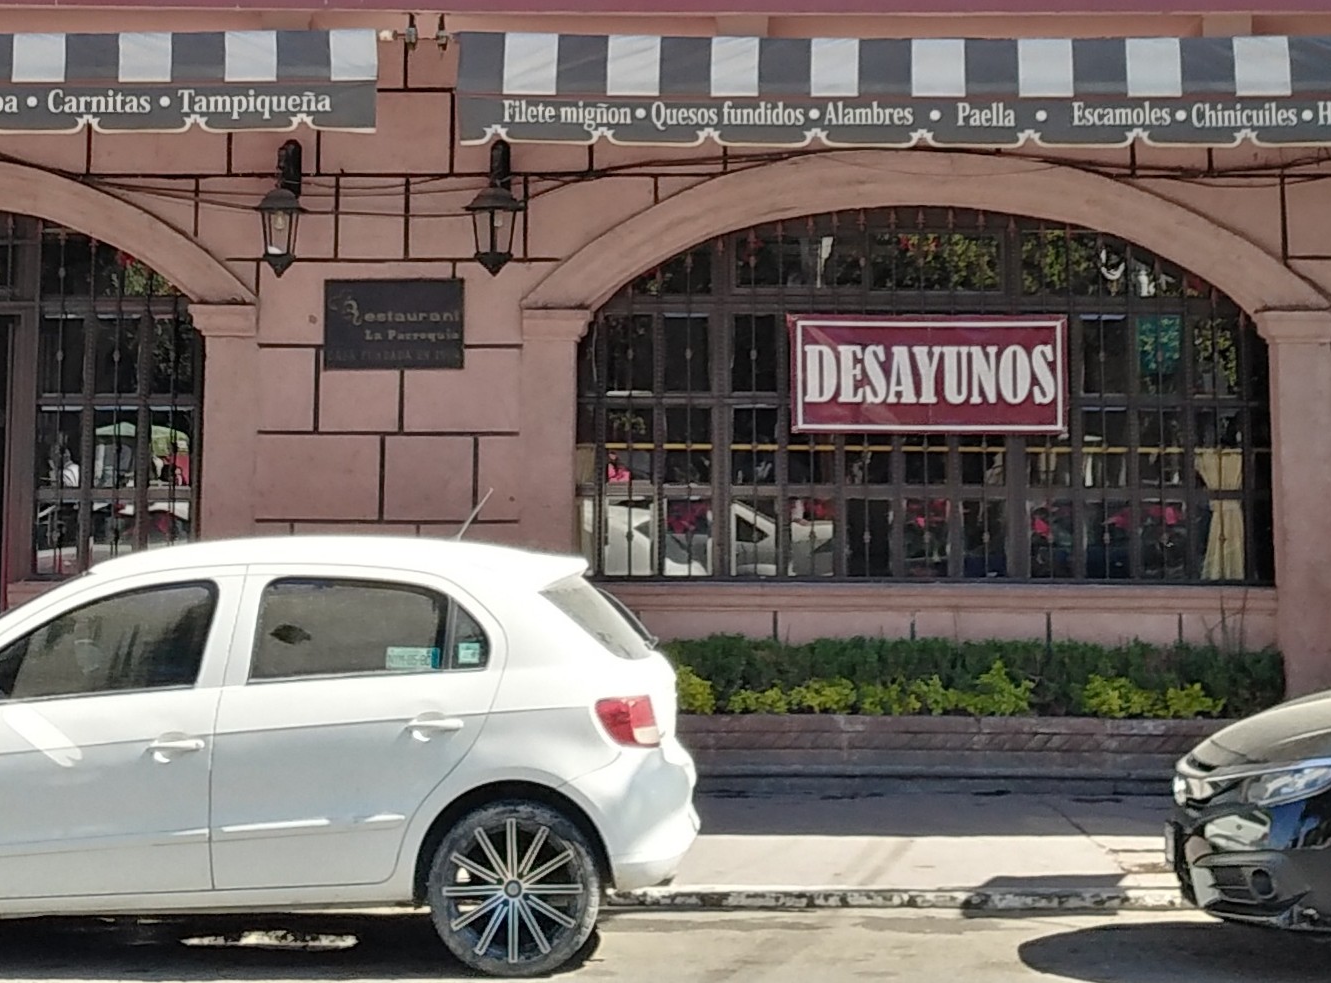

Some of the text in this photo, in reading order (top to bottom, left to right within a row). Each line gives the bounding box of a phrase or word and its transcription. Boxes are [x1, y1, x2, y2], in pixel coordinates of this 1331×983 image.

[47, 88, 151, 114] Carnitas
[177, 88, 332, 119] Tampiqueña
[502, 99, 556, 124] Filete
[560, 101, 632, 130] migñon
[651, 102, 718, 129] Quesos
[722, 101, 805, 126] fundidos
[824, 101, 914, 126] Alambres
[956, 102, 1015, 128] Paella
[1072, 101, 1171, 127] Escamoles
[1191, 101, 1298, 128] Chinicuiles
[803, 344, 1056, 405] DESAYUNOS
